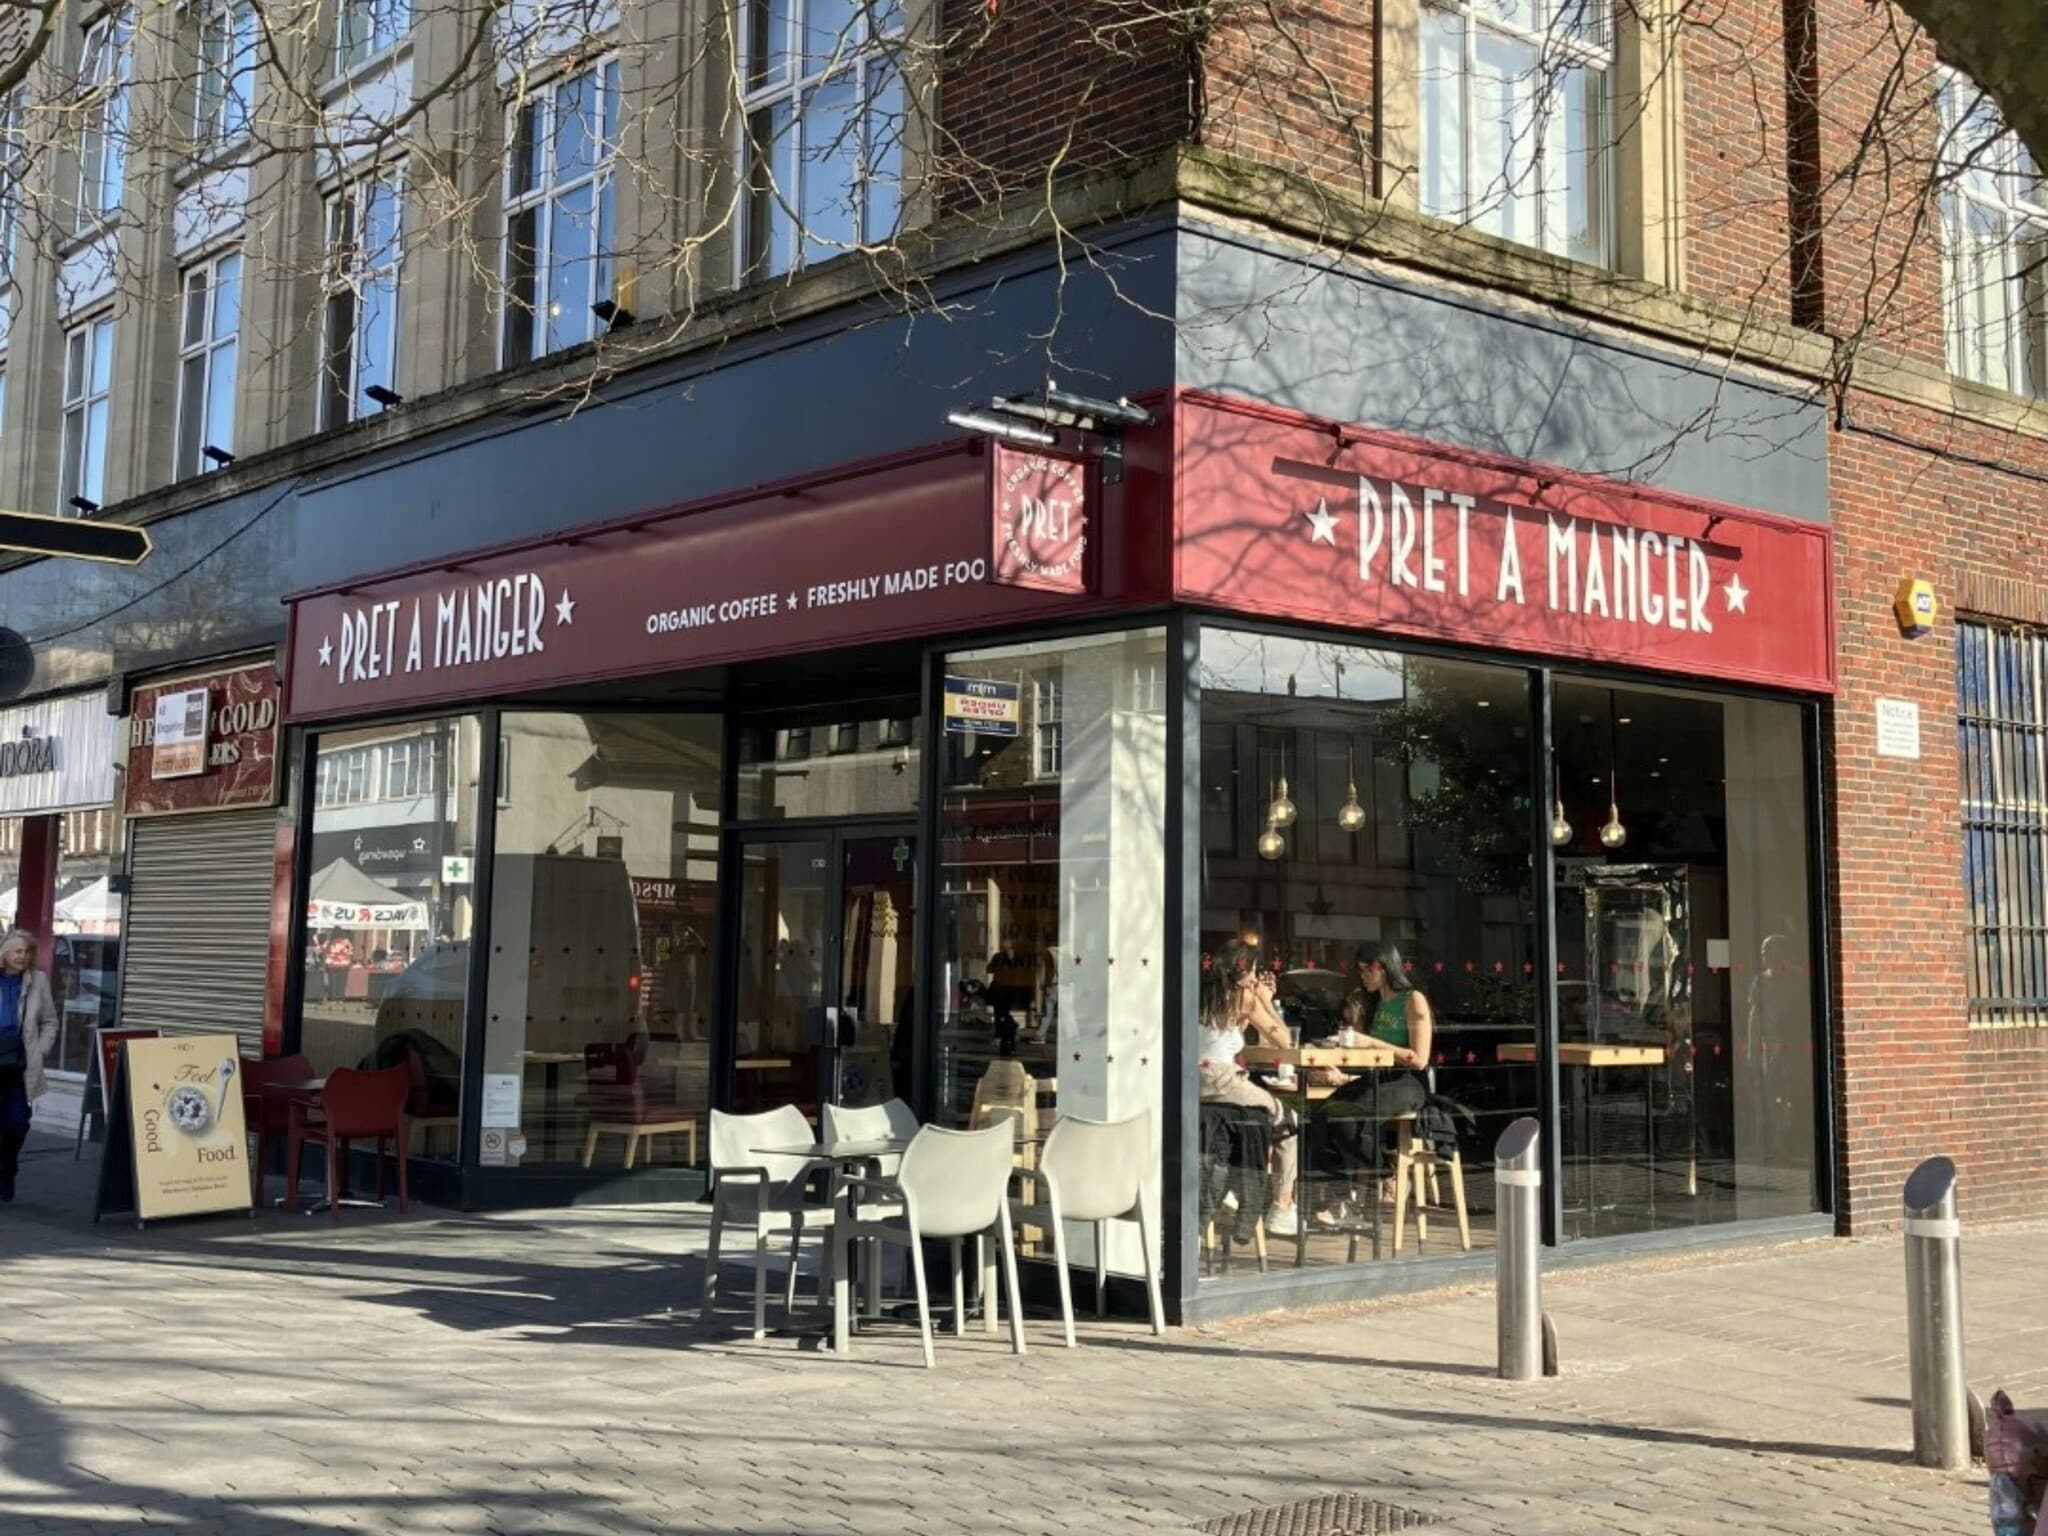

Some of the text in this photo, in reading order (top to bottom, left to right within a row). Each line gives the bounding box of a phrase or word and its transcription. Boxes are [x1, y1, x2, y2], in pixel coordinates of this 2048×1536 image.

[1021, 493, 1071, 543] PRET
[1358, 474, 1712, 634] PRET A MANGER
[646, 557, 986, 634] ORGANIC COFFEE FRESHLY MADE FOO
[338, 572, 545, 684] PRET A MANGER
[219, 698, 274, 736] GOLD
[0, 735, 56, 778] DORA
[208, 739, 241, 766] ERS
[144, 1108, 162, 1153] Good
